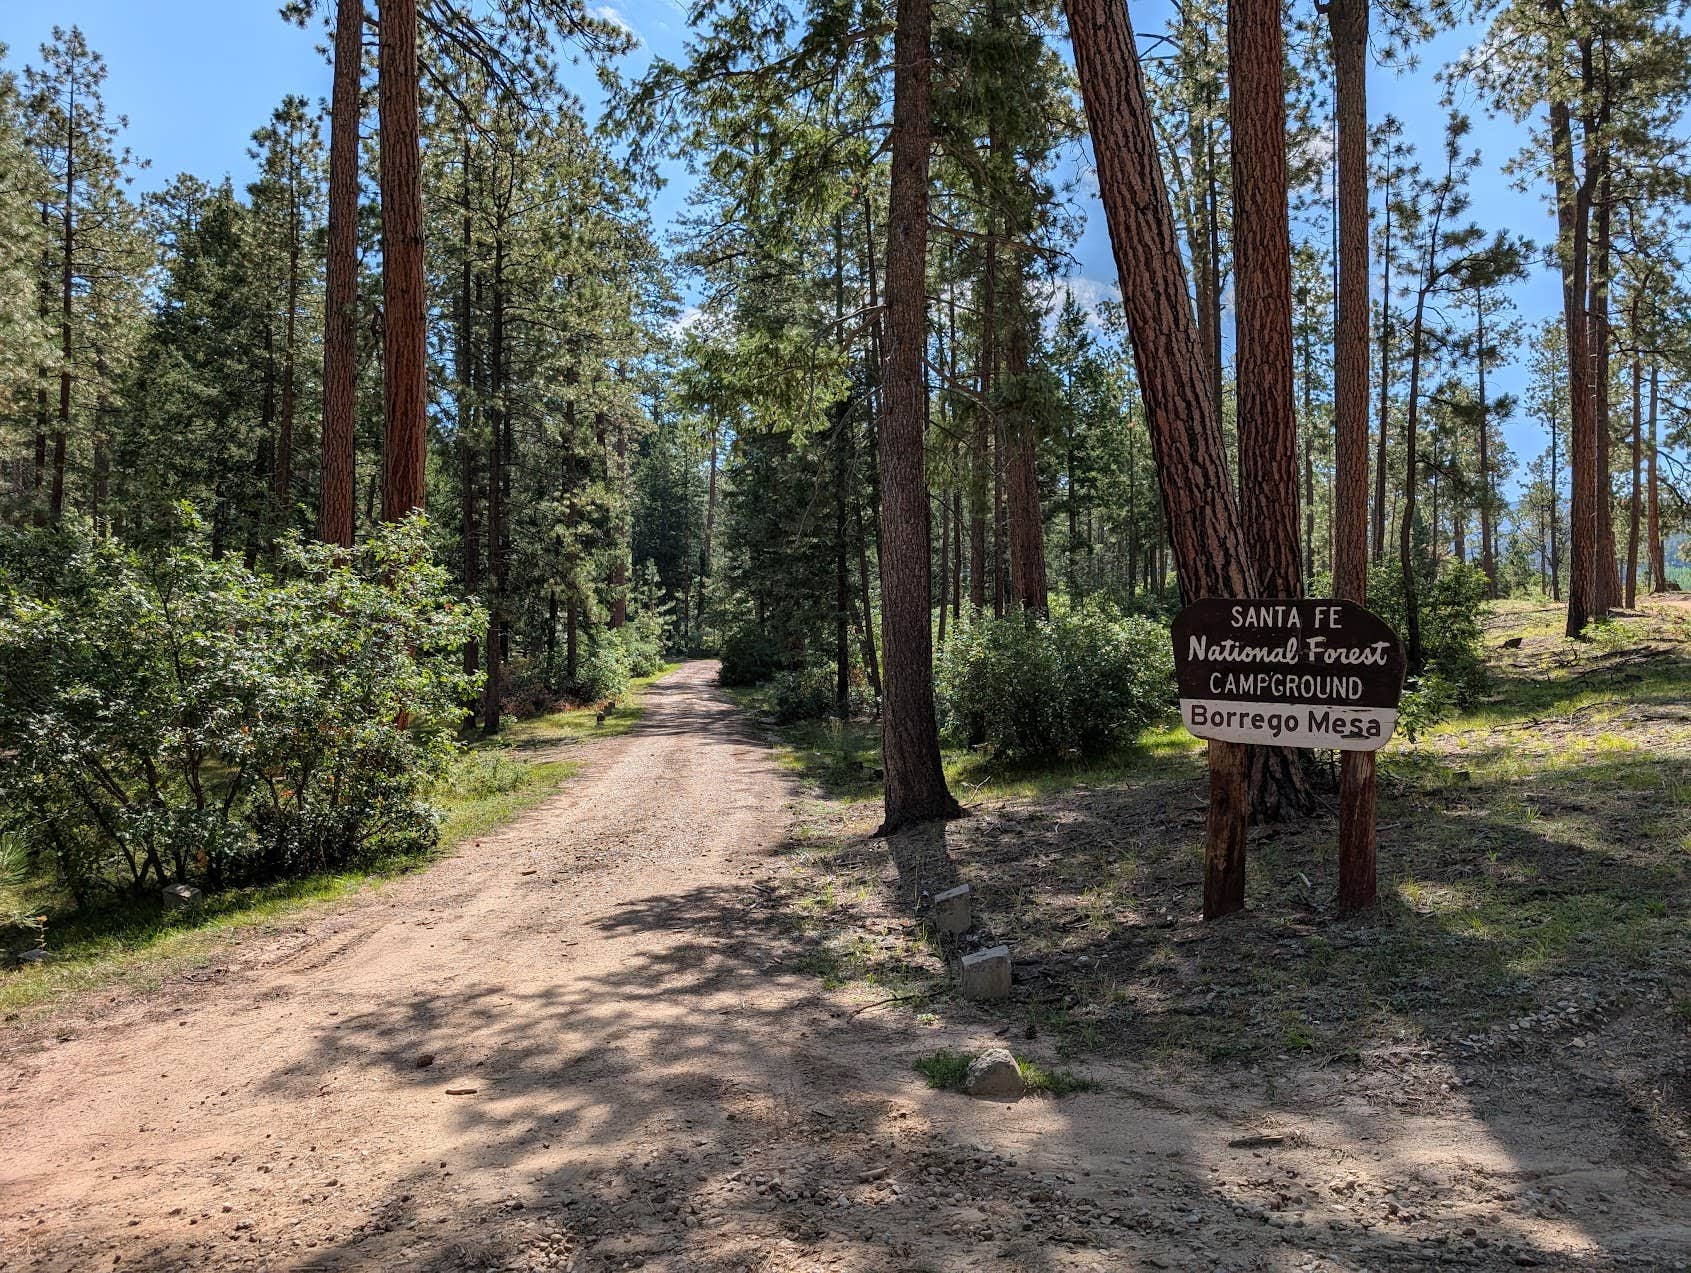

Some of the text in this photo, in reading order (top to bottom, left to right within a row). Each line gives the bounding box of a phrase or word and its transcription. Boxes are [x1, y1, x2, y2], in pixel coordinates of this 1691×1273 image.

[1231, 606, 1342, 629] SANTA FE
[1188, 634, 1391, 666] National Forest
[1209, 672, 1363, 700] CAMPGROUND
[1191, 704, 1381, 738] Borrego Mesa
